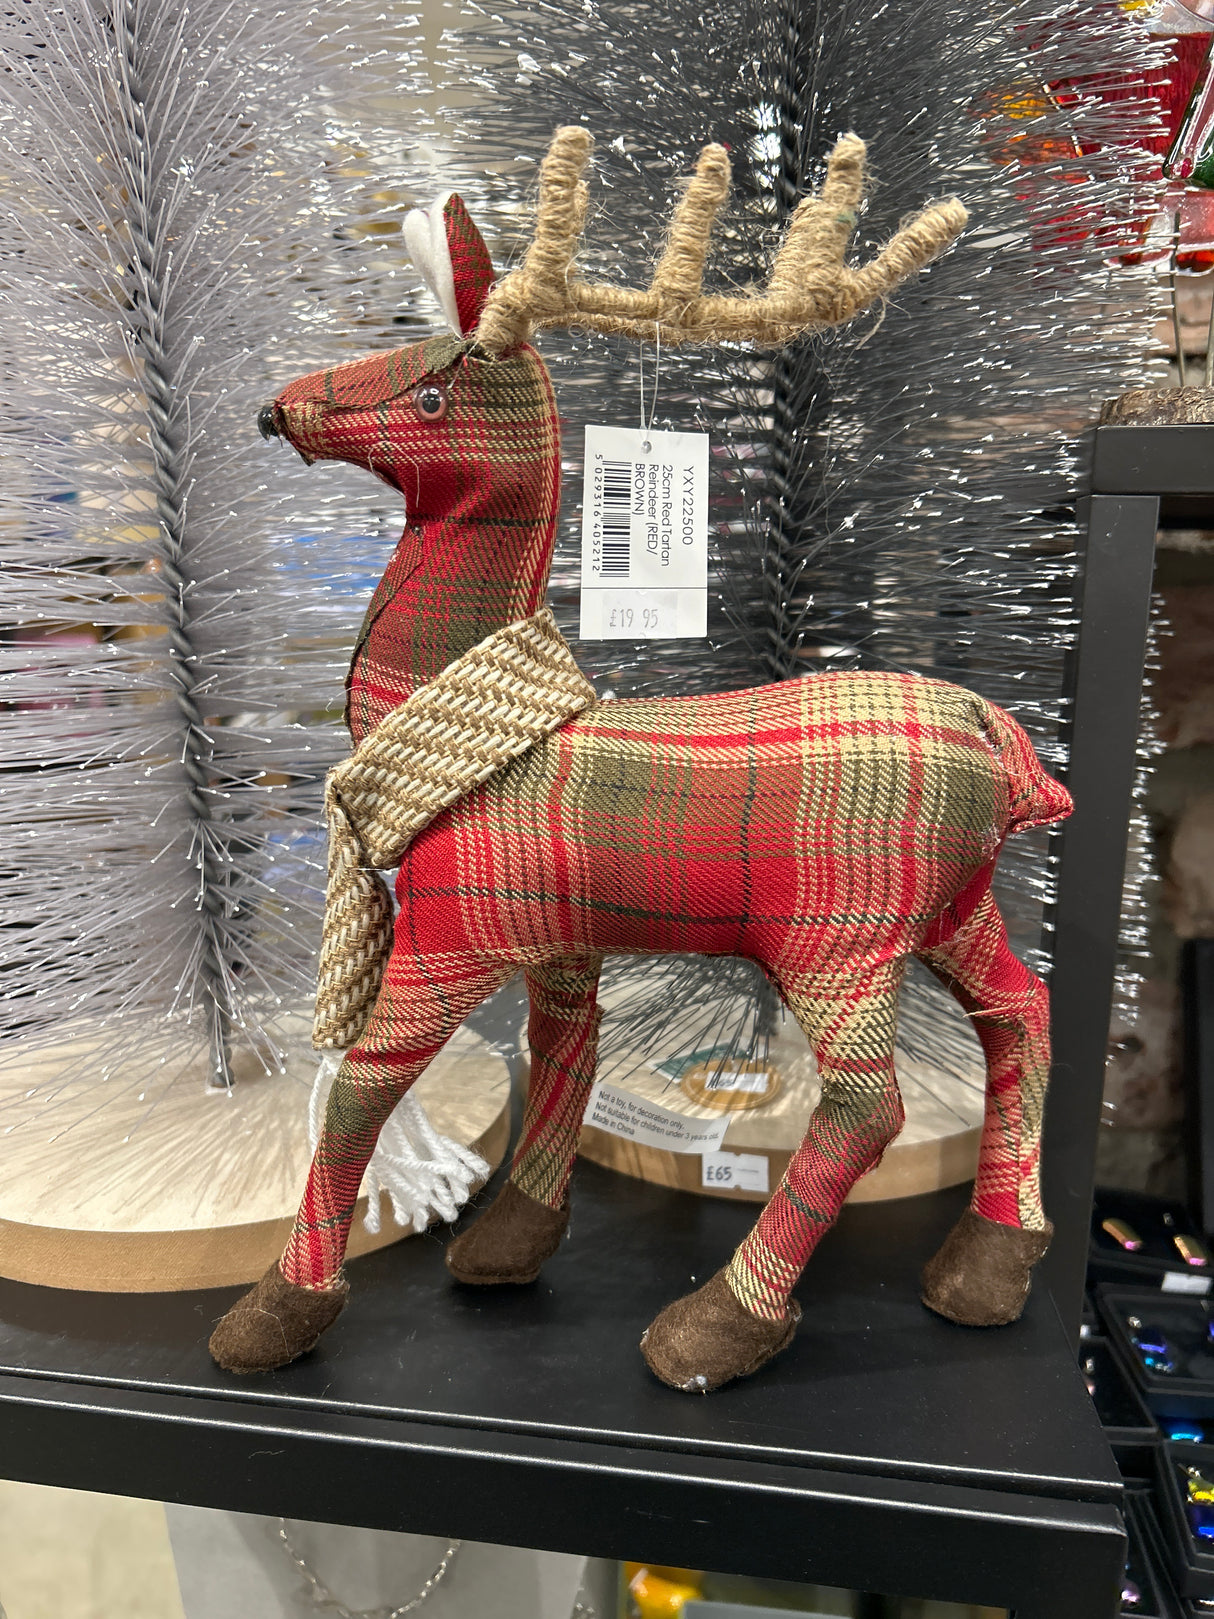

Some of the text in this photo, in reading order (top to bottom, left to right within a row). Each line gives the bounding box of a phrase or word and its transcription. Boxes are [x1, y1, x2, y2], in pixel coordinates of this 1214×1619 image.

[593, 468, 602, 517] 029316
[632, 463, 645, 516] BROWN)
[646, 464, 659, 555] Reindeer (RED/
[683, 466, 694, 545] YXY22500
[661, 465, 673, 567] 25cm Red Tartan
[592, 523, 601, 571] 405212
[592, 1112, 636, 1136] Made in China
[595, 1102, 607, 1111] Not
[607, 1106, 631, 1122] suitable
[632, 1115, 640, 1125] for
[641, 1121, 665, 1134] children
[665, 1130, 685, 1140] under
[691, 1133, 708, 1142] years
[599, 1091, 610, 1100] Not
[629, 1102, 637, 1112] for
[638, 1108, 669, 1126] decoration
[706, 1166, 733, 1181] £65
